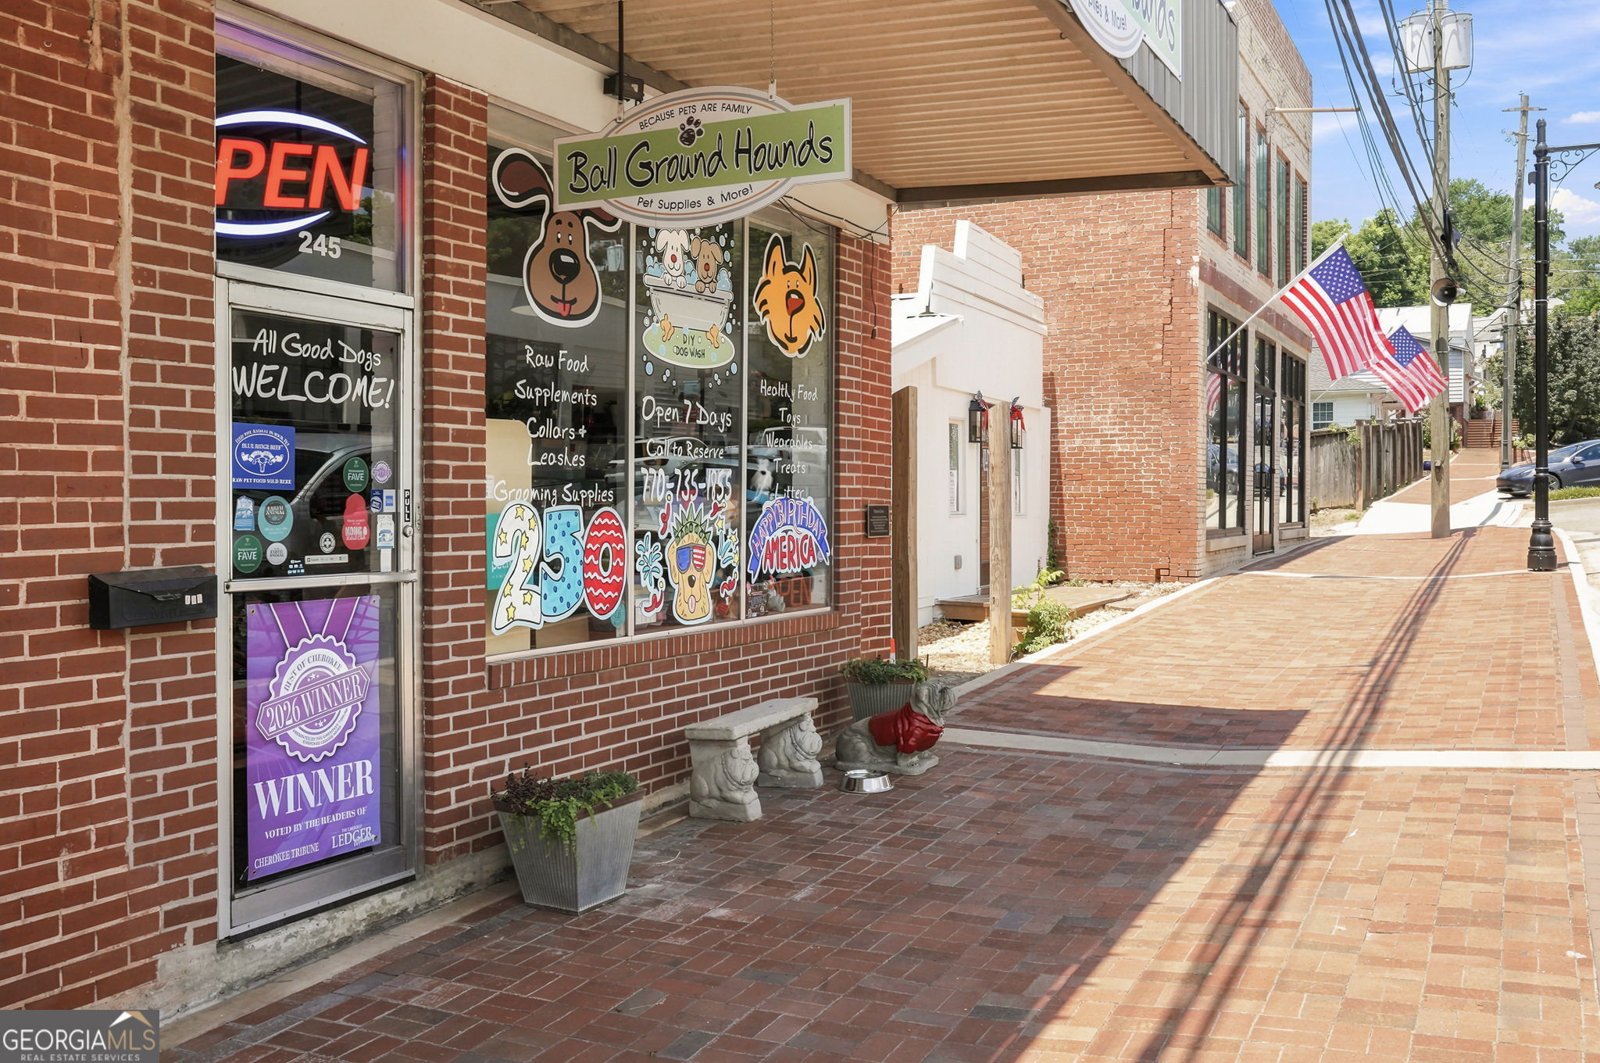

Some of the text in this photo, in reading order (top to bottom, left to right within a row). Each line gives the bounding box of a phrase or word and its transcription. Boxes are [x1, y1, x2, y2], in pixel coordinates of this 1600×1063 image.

[639, 102, 753, 130] BECAUSE PETS ARE FAMILY
[566, 120, 833, 193] Ball Ground Hounds
[215, 138, 369, 211] PEN
[637, 184, 753, 212] Pet Supplies & More!
[298, 231, 341, 259] 245
[252, 328, 381, 372] All Good Dogs
[675, 345, 706, 359] DOG WASH
[683, 333, 696, 345] DIY
[525, 344, 589, 373] Raw Food
[232, 361, 395, 409] WELCOME!
[514, 379, 597, 407] Supplements
[760, 379, 818, 402] Healthy Food
[526, 416, 575, 440] Collars
[642, 395, 732, 433] Open 7 Days
[778, 407, 801, 428] Toys
[527, 443, 586, 467] Leashes
[646, 437, 724, 460] Call to Reserve
[347, 473, 365, 481] FAVE
[773, 458, 806, 474] Treats
[493, 479, 614, 508] Grooming Supplies
[238, 551, 257, 561] FAVE
[764, 532, 817, 571] AMERICA
[493, 501, 626, 633] 250
[296, 661, 306, 674] OF
[300, 674, 362, 718] WINNER
[253, 759, 375, 820] WINNER
[264, 806, 367, 840] VOTED BY THE READERS OF
[331, 826, 373, 849] LEDGER
[254, 842, 320, 869] CHEROKEE TRIBUNE
